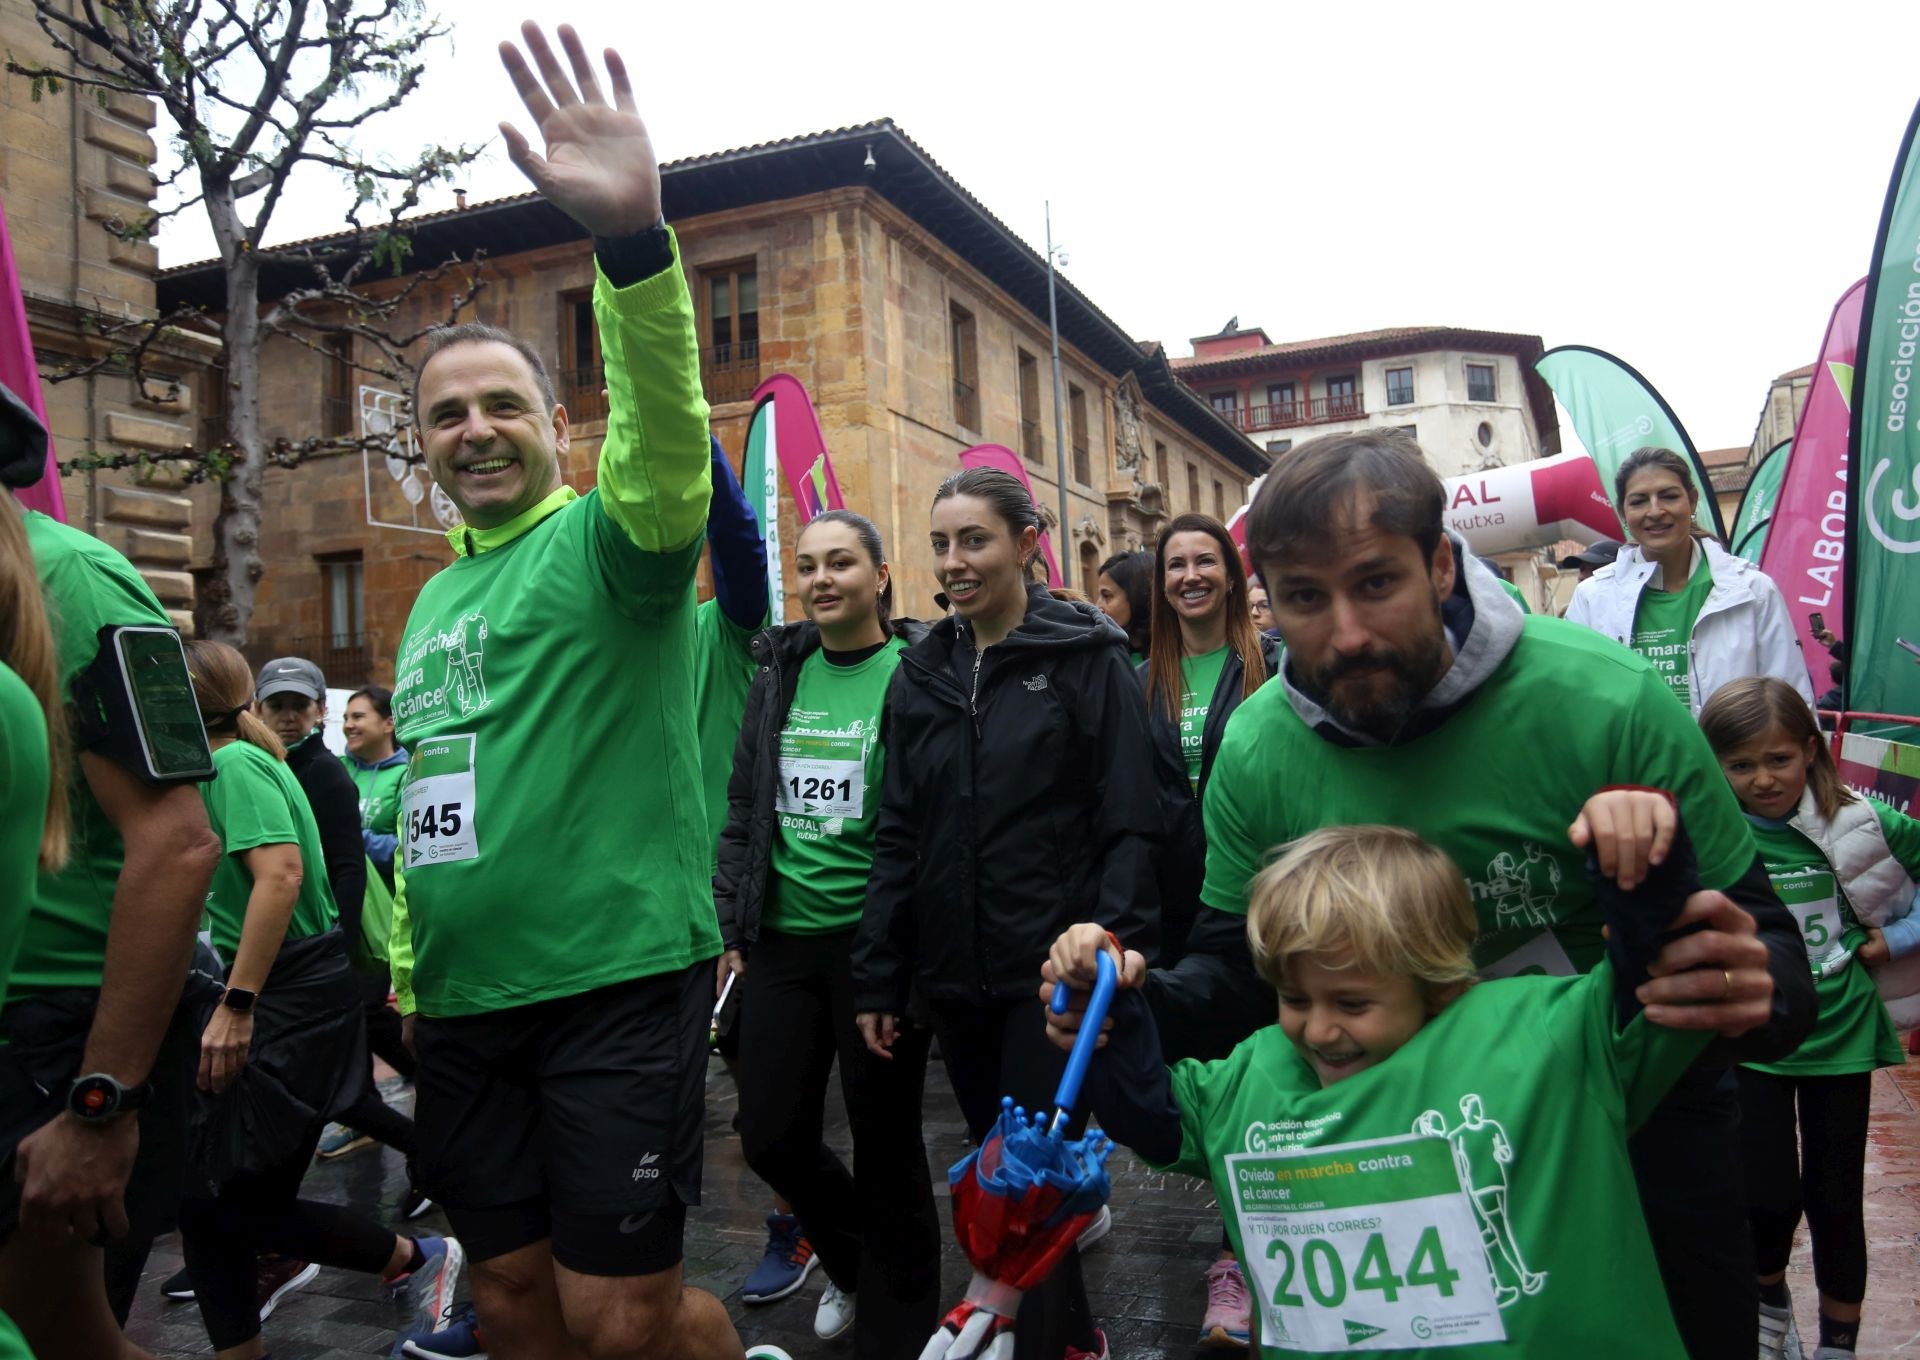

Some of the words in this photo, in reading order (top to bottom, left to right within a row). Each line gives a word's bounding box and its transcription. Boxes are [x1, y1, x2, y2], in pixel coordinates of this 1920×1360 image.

[1443, 479, 1502, 513] AL
[1451, 511, 1505, 532] kutxa
[423, 745, 450, 757] contra
[789, 776, 851, 802] 1261
[405, 802, 462, 845] 1545
[1782, 880, 1814, 890] contra
[631, 1168, 660, 1182] ipso
[1239, 1168, 1275, 1182] Oviedo
[1276, 1169, 1292, 1182] en
[1295, 1160, 1355, 1180] marcha
[1358, 1153, 1413, 1172] contra
[1242, 1186, 1254, 1200] el
[1255, 1186, 1291, 1200] cáncer
[1248, 1224, 1255, 1235] Y
[1256, 1221, 1269, 1235] TÚ
[1290, 1219, 1325, 1236] QUIÉN
[1327, 1216, 1382, 1232] CORRES?
[1266, 1225, 1461, 1309] 2044
